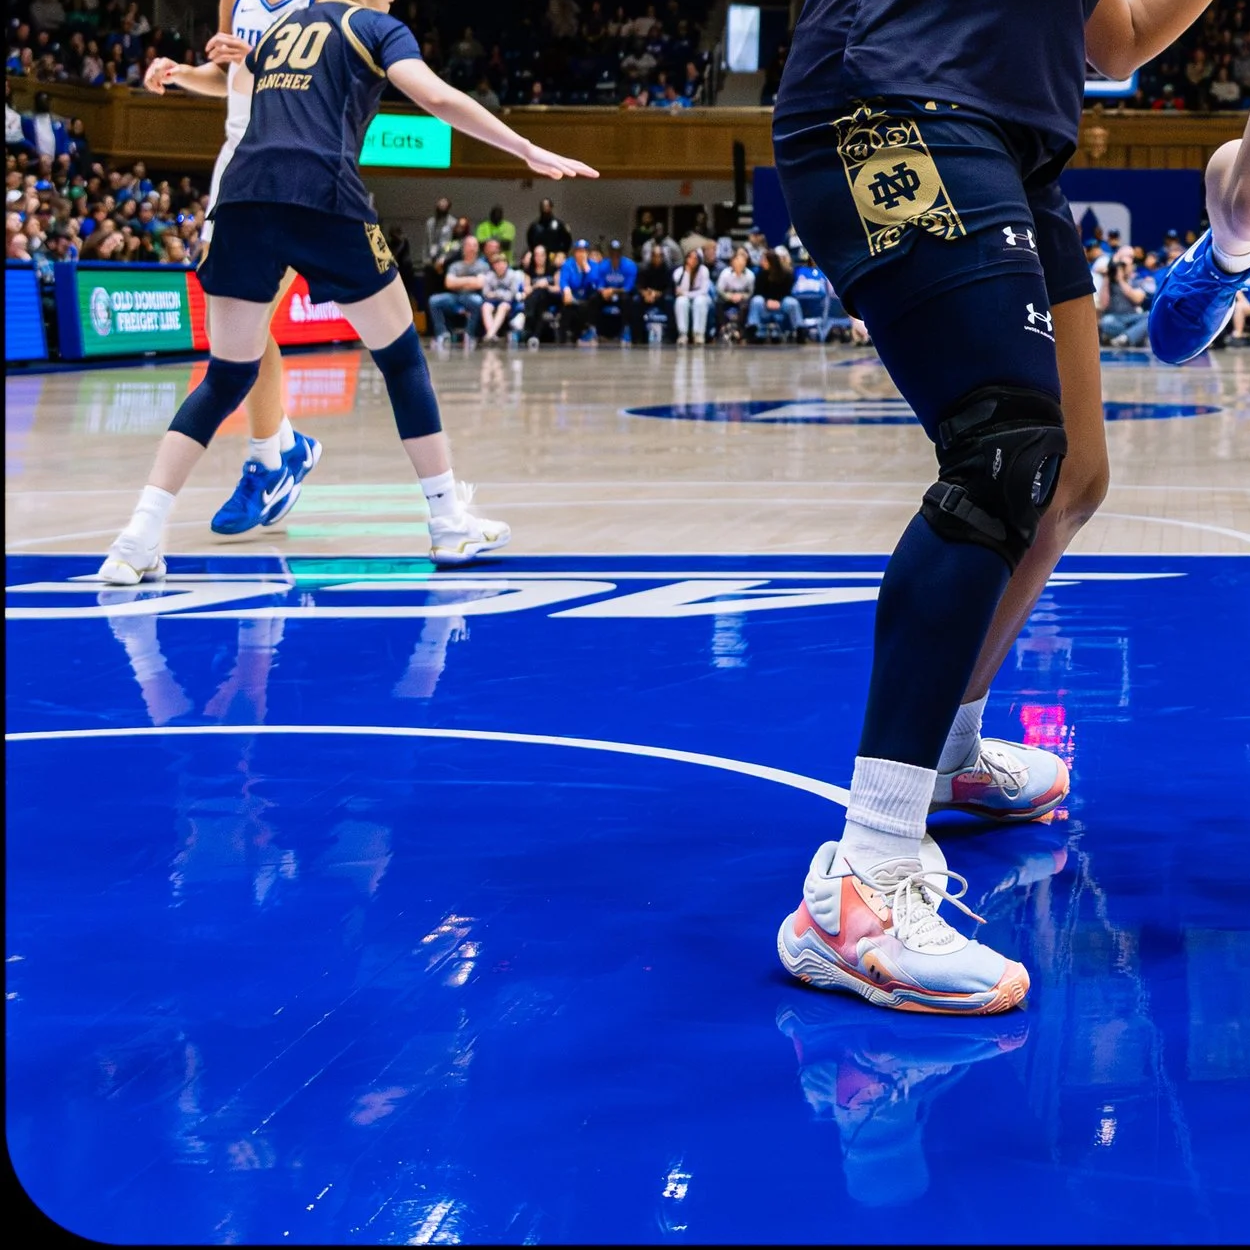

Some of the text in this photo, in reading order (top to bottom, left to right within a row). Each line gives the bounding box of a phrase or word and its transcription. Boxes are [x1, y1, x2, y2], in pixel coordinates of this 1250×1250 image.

[264, 22, 332, 70] 30
[256, 73, 313, 93] SANCHEZ
[381, 131, 424, 149] Eats
[113, 290, 182, 310] OLD DOMINION
[118, 310, 182, 332] FREIGHT LINE
